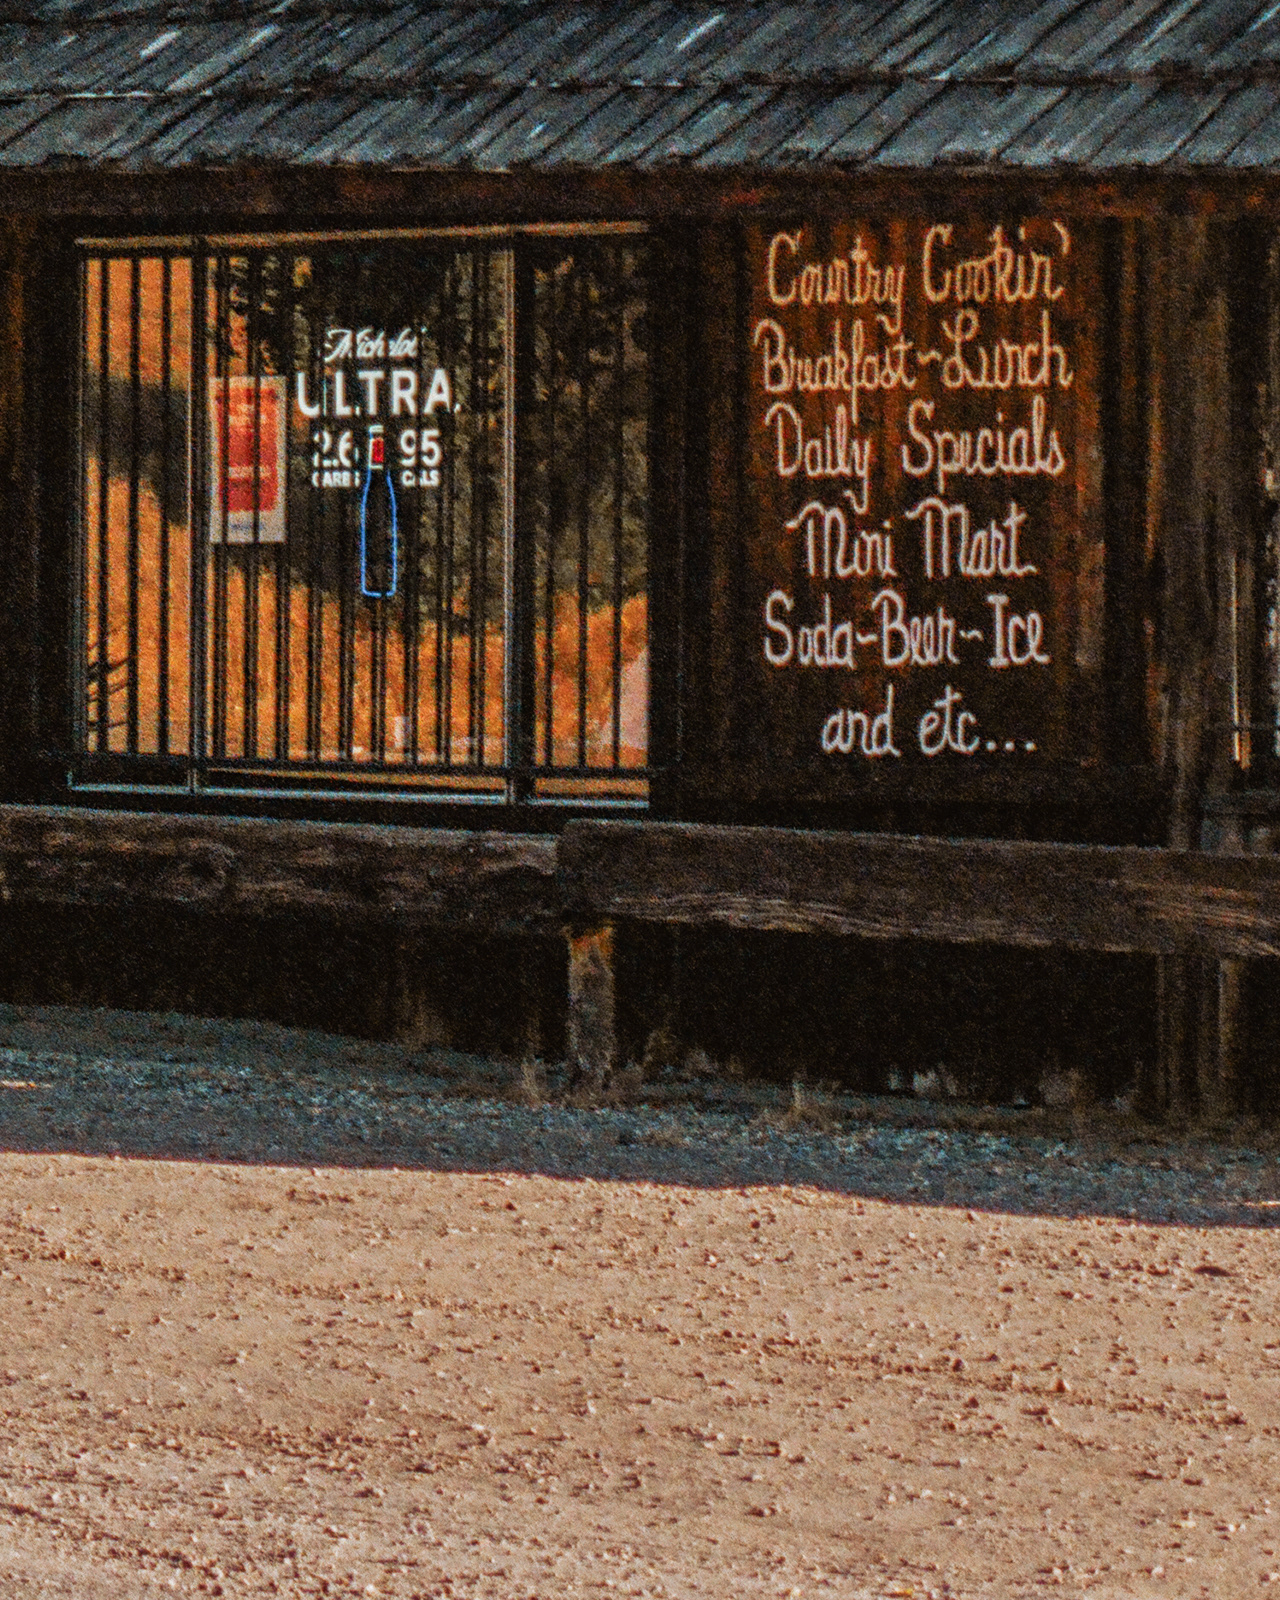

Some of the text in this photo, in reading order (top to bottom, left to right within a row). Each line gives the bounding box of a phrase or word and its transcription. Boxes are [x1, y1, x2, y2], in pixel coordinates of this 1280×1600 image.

[767, 221, 1071, 335] Country Cookin'
[296, 368, 461, 418] ULTRA
[400, 428, 442, 468] 95
[764, 394, 1066, 515] Daily Specials
[785, 496, 1038, 580] Mini Mart
[821, 683, 901, 757] and
